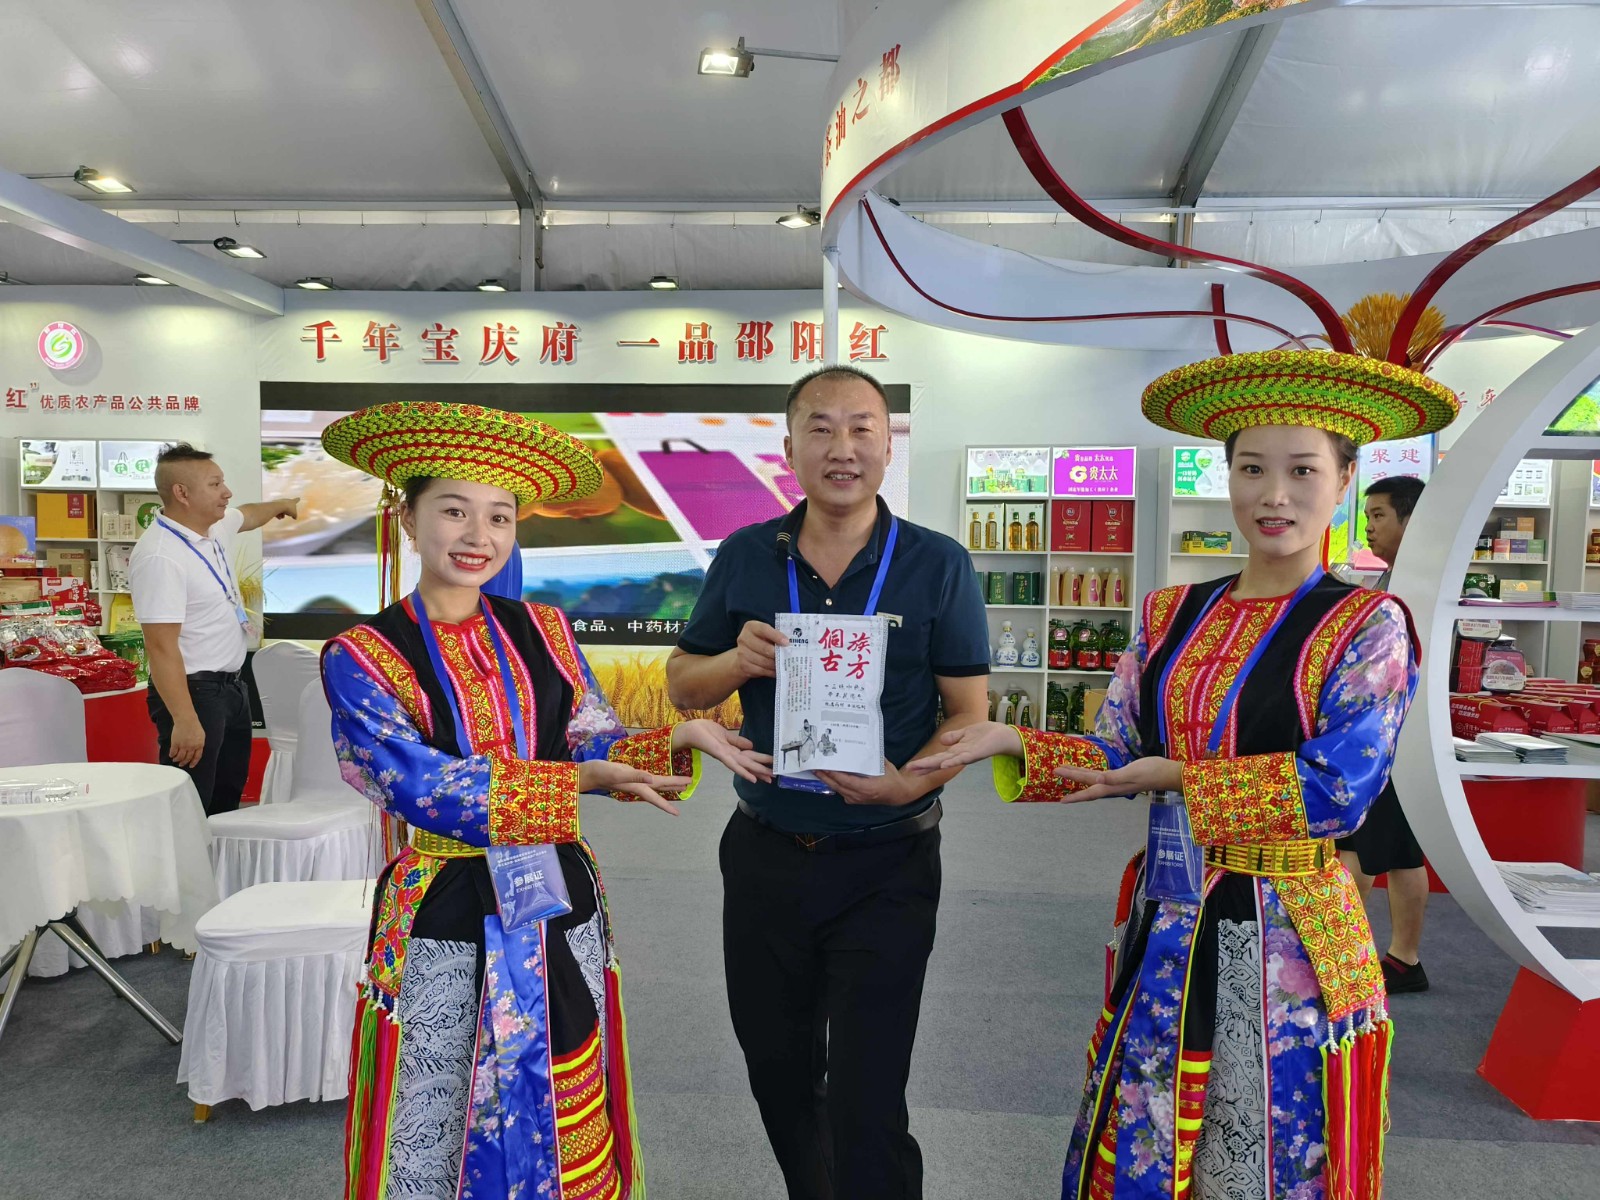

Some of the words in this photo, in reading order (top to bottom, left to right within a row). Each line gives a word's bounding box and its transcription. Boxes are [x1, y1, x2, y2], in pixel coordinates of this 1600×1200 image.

[300, 320, 582, 365] 千年宝庆府
[618, 320, 889, 363] 一品邵阳红
[40, 394, 200, 411] 优质农产品公共品牌
[1089, 465, 1119, 481] 贵太太
[571, 619, 687, 634] 食品、中药材
[820, 649, 870, 680] 古方
[1158, 848, 1184, 862] 参展证
[513, 869, 545, 888] 参展证
